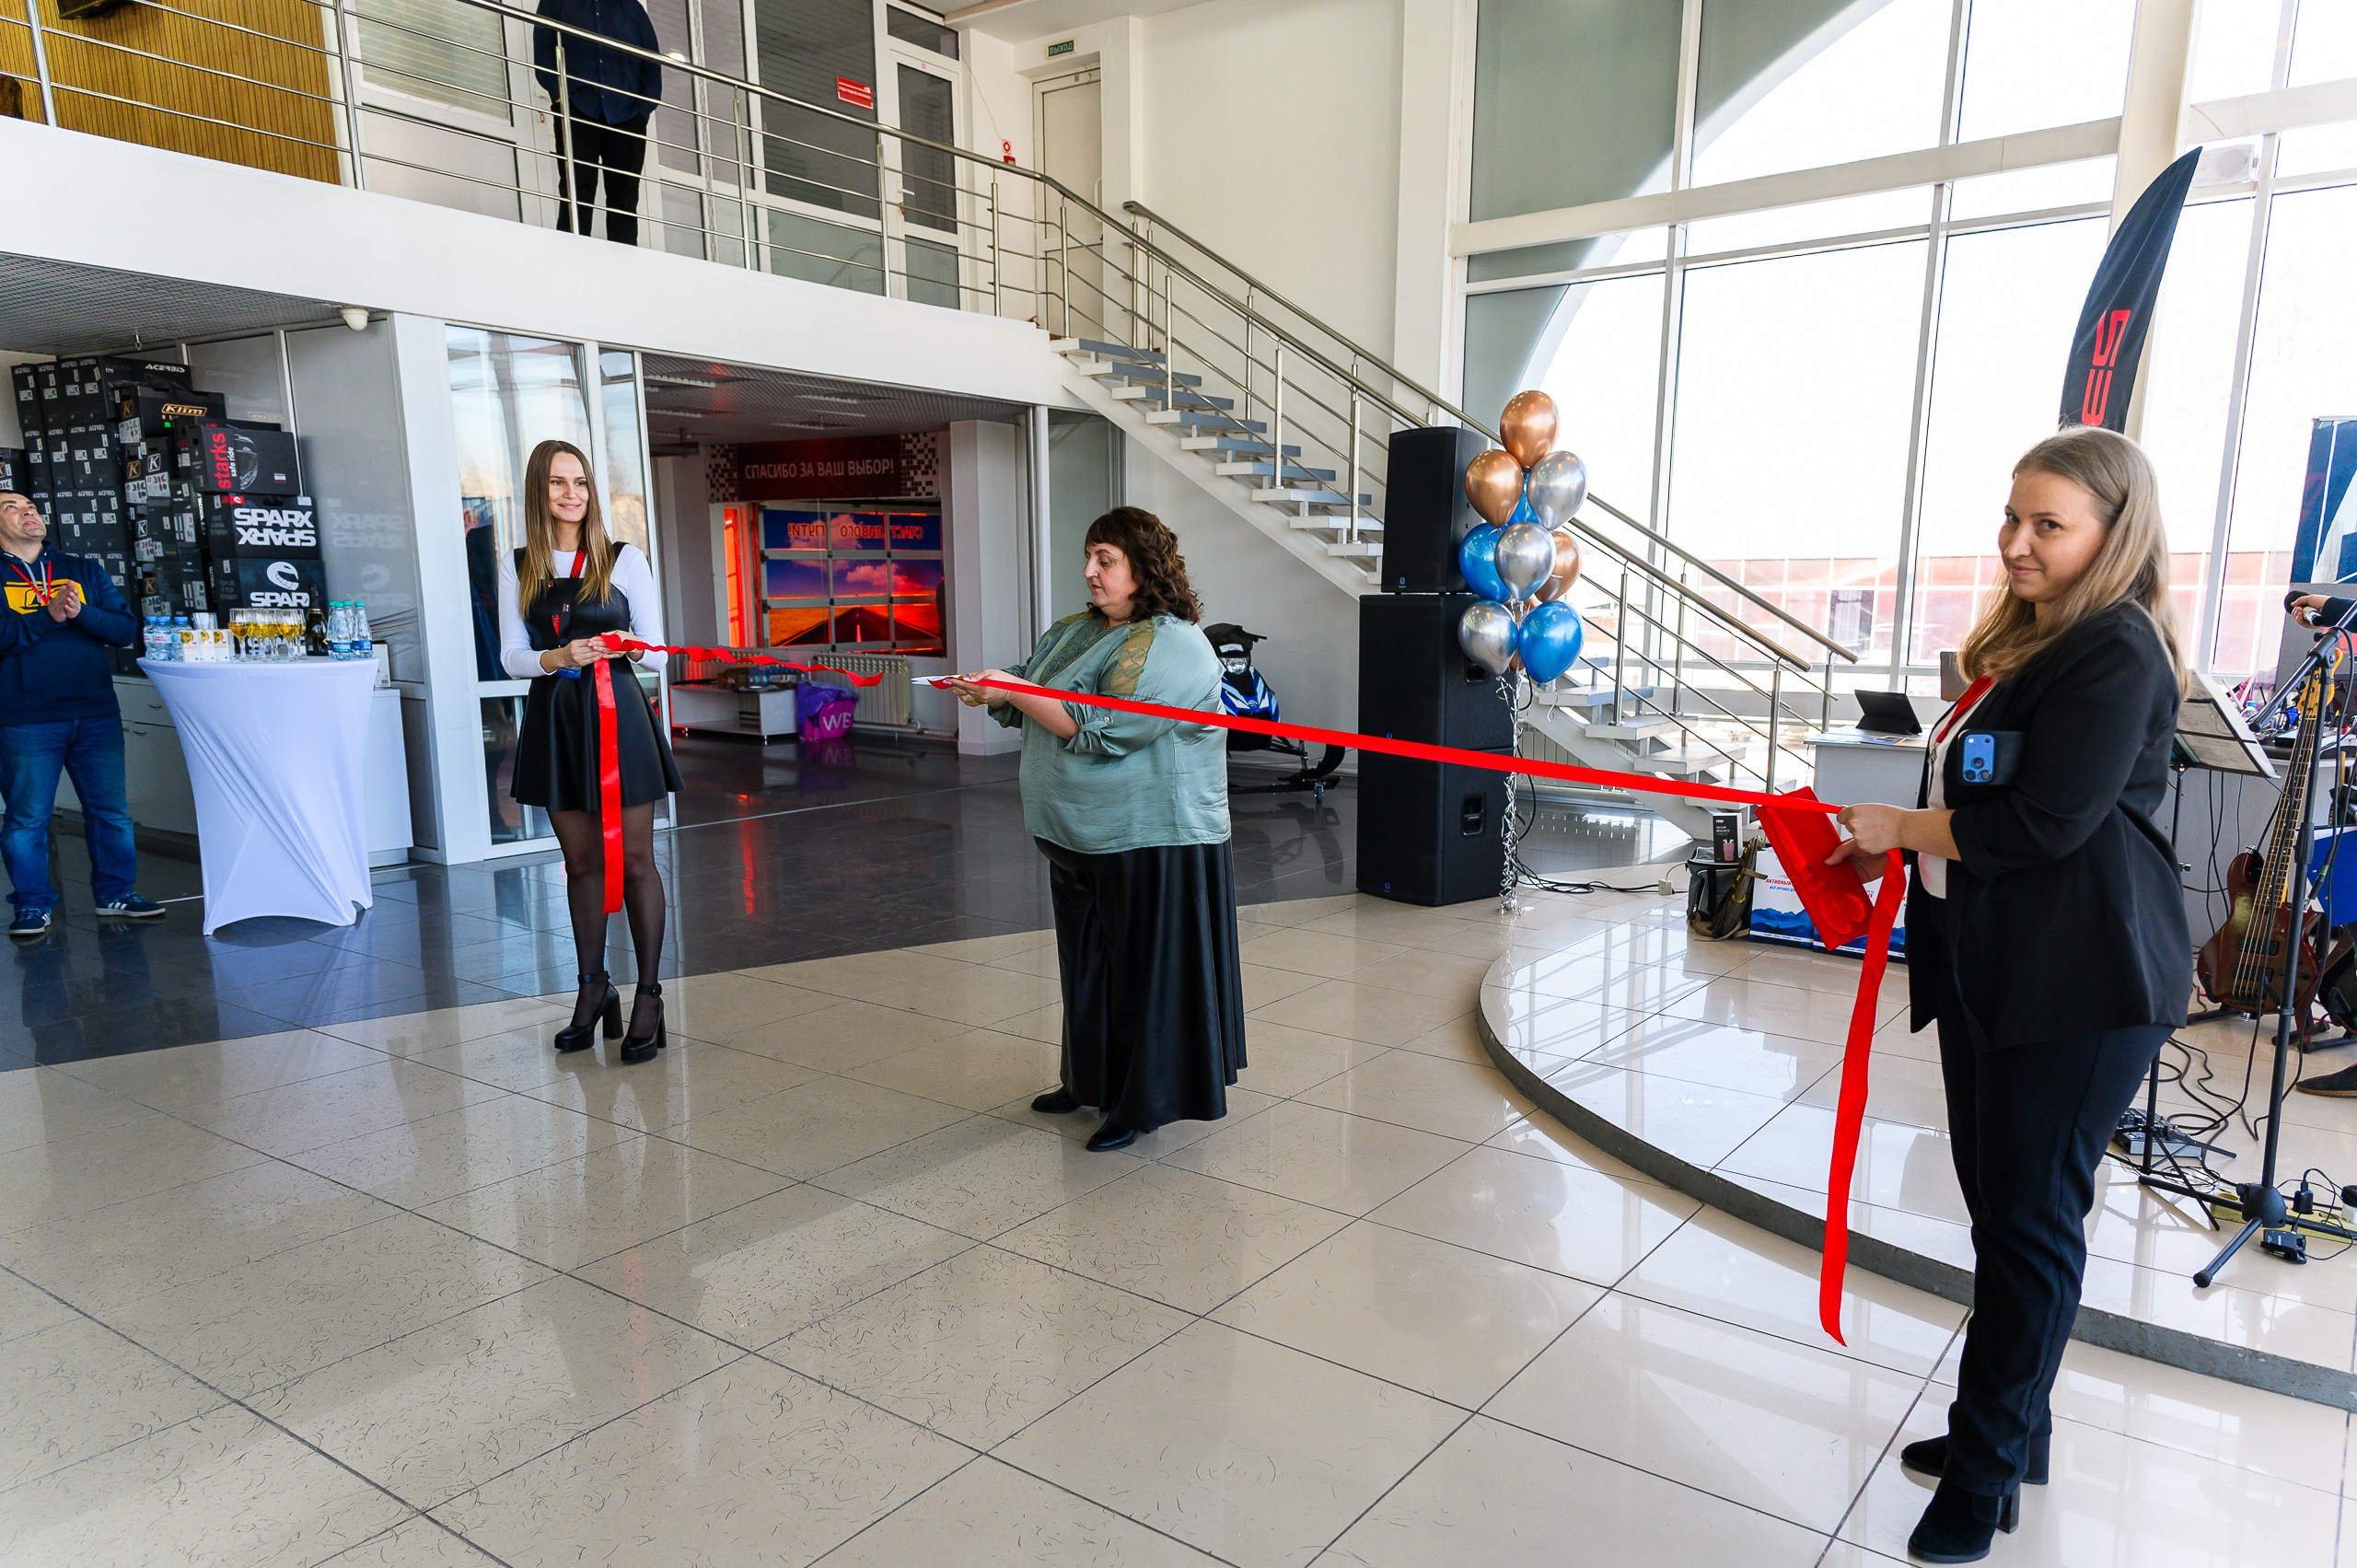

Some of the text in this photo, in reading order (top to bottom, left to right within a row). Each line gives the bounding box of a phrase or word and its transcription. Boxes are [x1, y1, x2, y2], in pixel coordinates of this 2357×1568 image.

[1049, 41, 1073, 55] ВЫХОД
[129, 461, 140, 478] K
[149, 455, 160, 471] K
[210, 433, 232, 490] starks
[227, 447, 237, 477] safe ride
[745, 459, 895, 480] СПАСИБО ЗА ВАШ ВЫБОР!
[234, 508, 314, 528] SPARX
[236, 528, 317, 547] SPARX
[250, 592, 310, 607] SPAR
